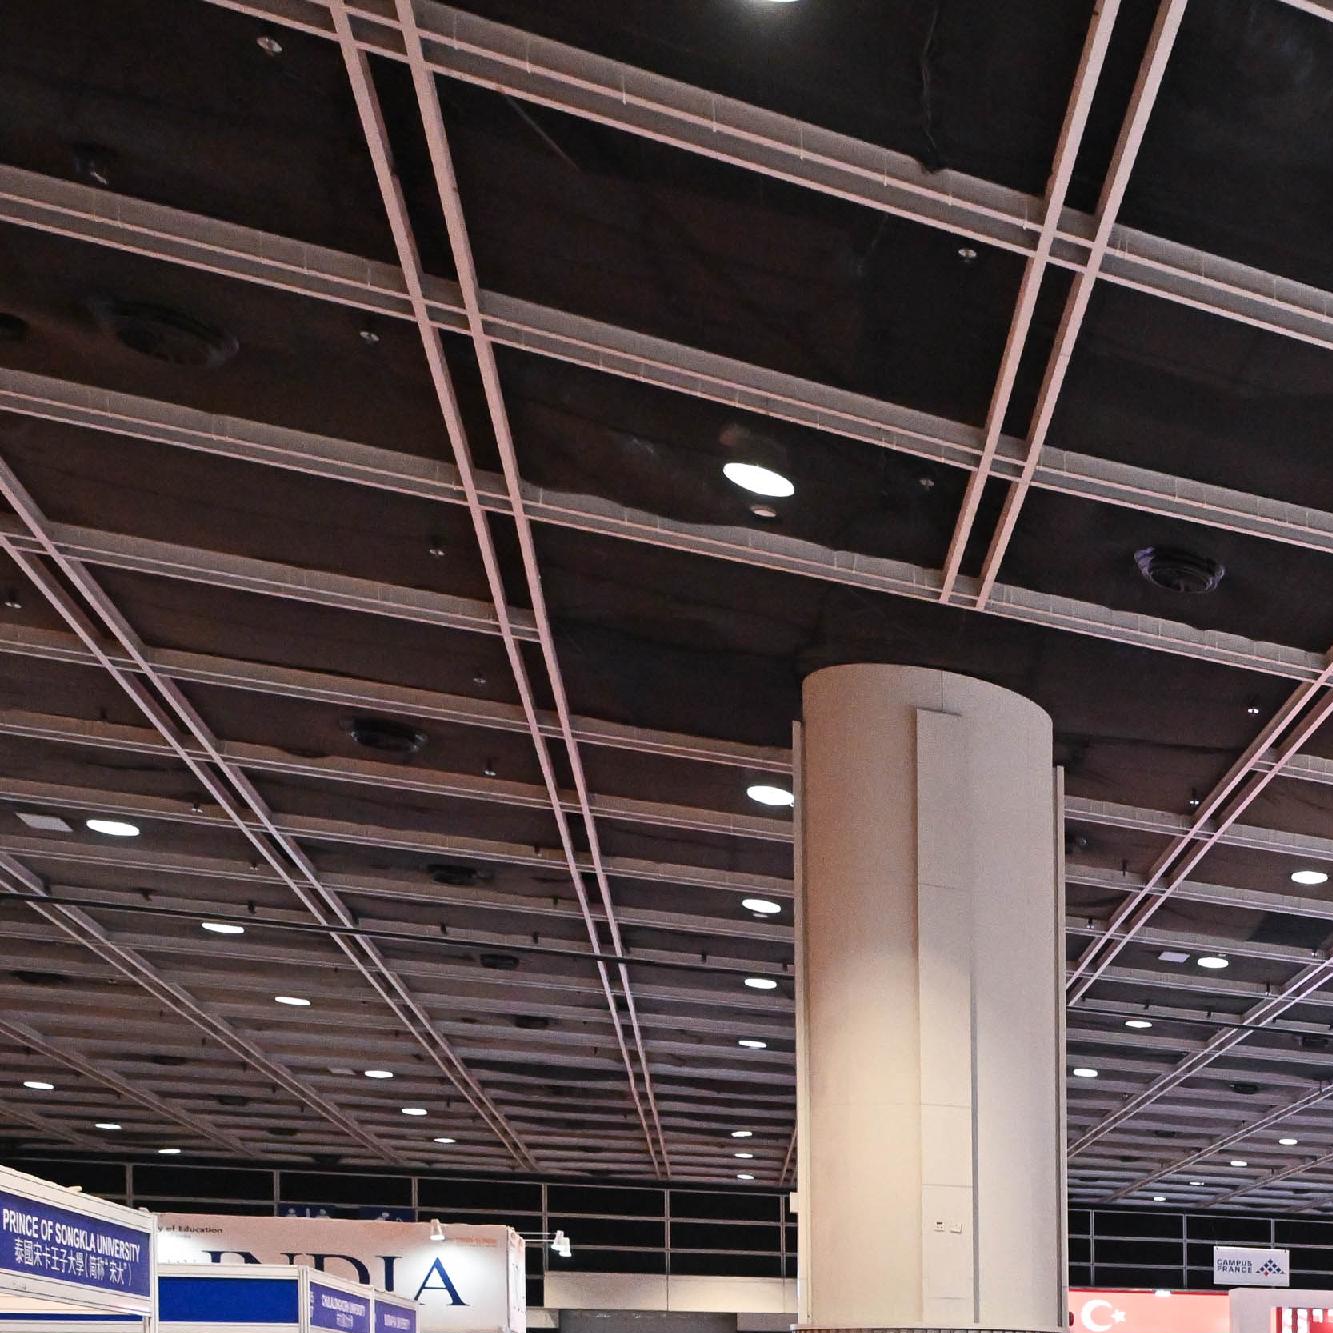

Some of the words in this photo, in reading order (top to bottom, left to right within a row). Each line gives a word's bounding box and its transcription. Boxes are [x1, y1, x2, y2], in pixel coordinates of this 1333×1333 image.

[3, 1209, 38, 1238] PRINCE
[41, 1220, 53, 1241] OF
[55, 1223, 96, 1253] SONGKLA
[97, 1234, 140, 1262] UNIVERSITY
